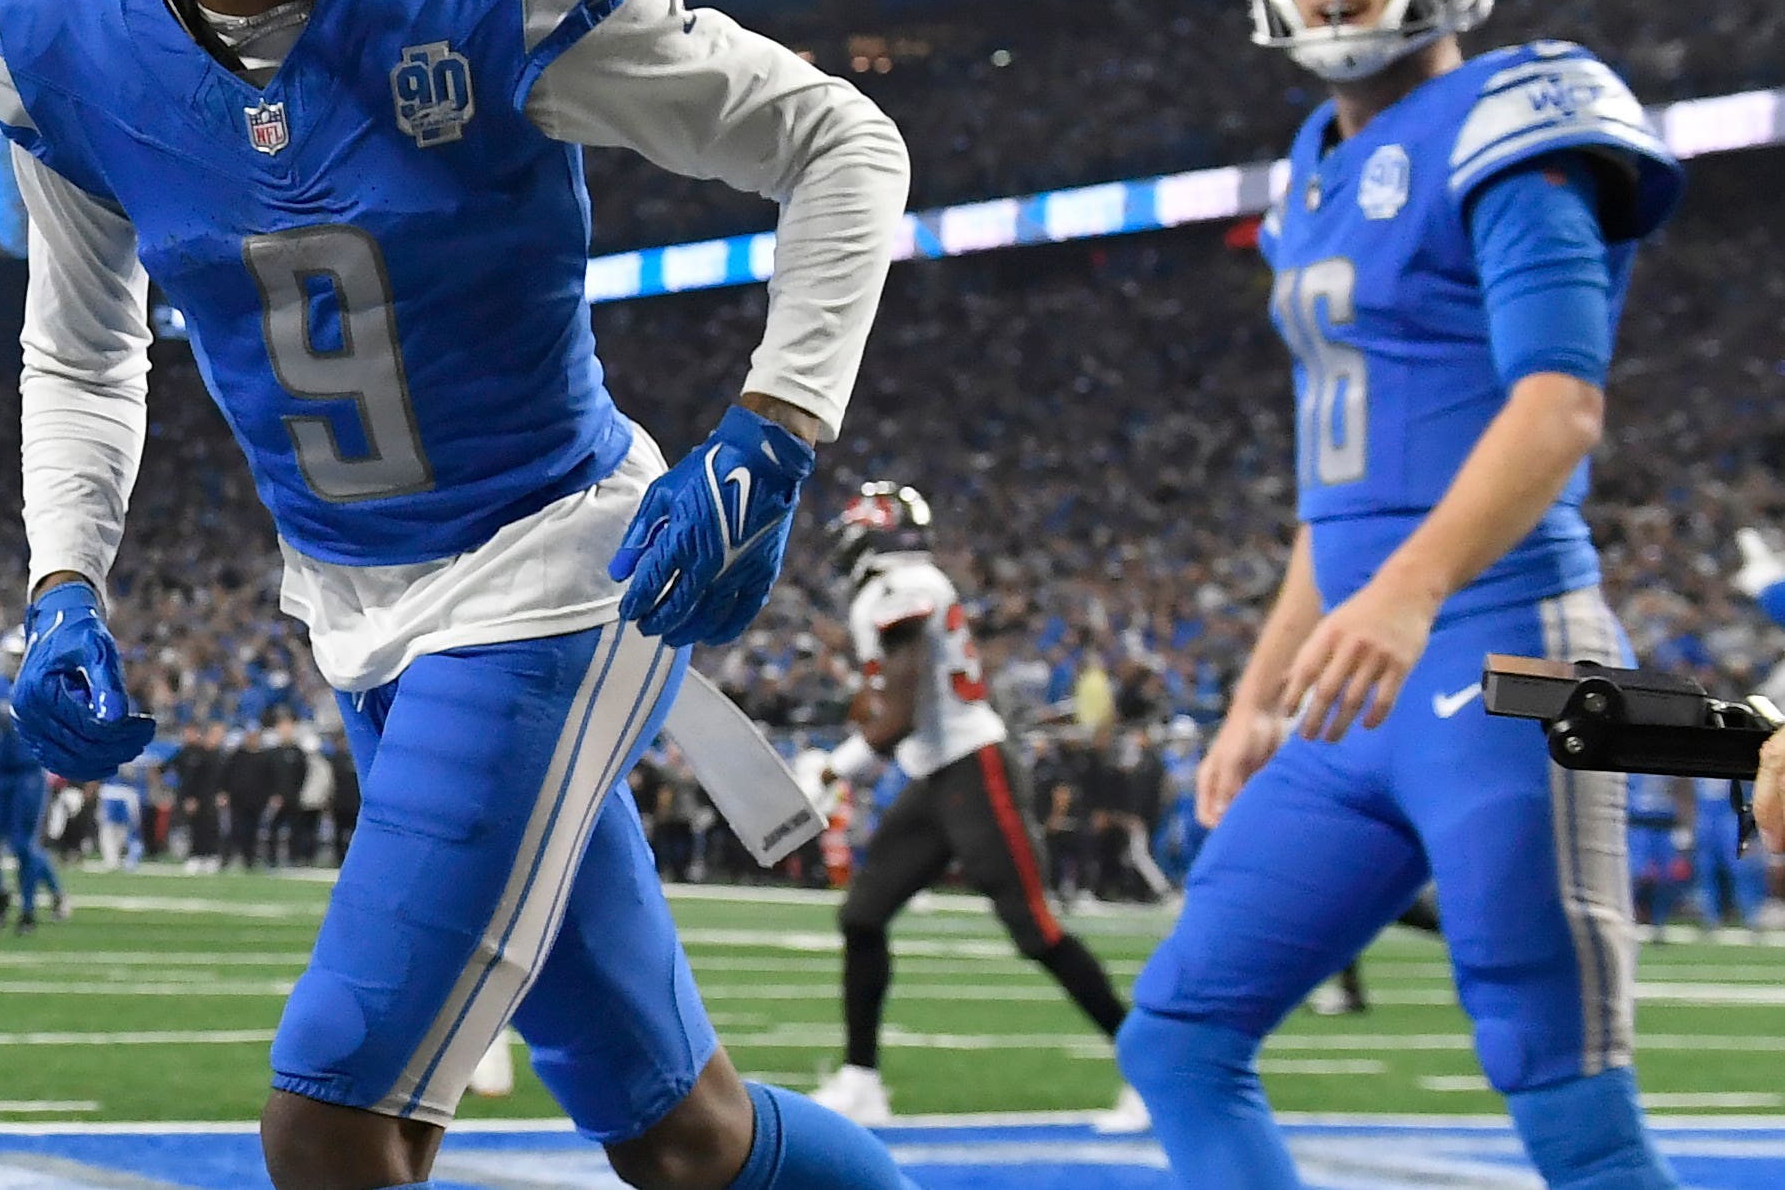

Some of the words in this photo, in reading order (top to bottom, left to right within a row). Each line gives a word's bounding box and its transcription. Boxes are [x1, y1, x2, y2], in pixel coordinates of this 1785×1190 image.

[256, 126, 283, 145] NFL
[395, 57, 472, 121] 90
[242, 222, 434, 503] 9
[1273, 257, 1367, 487] 16
